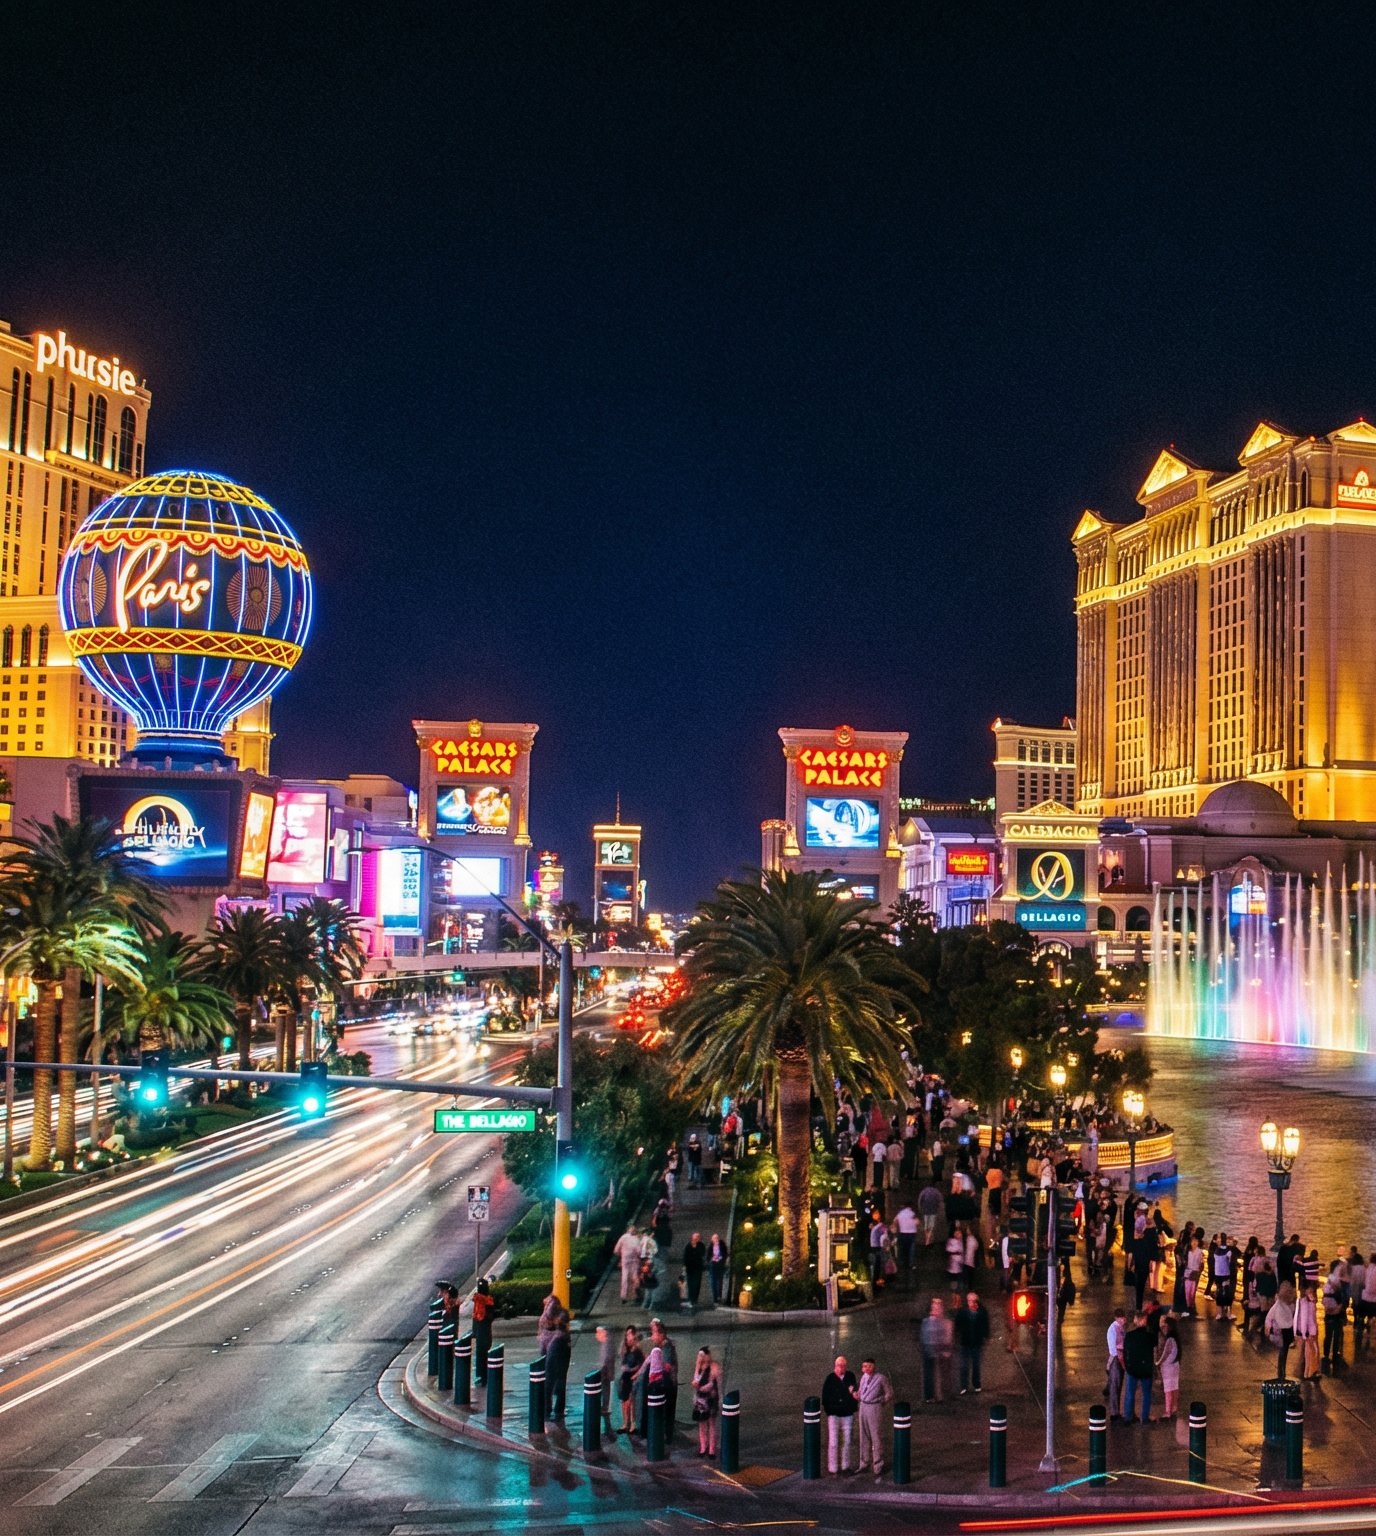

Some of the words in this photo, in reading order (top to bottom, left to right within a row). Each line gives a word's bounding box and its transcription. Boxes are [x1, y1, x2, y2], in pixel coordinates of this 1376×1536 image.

[115, 538, 211, 633] Paris
[431, 740, 518, 757] CAESARS
[437, 757, 512, 775] PALACE
[799, 750, 888, 769] CAESARS
[805, 769, 882, 787] PALACE
[1021, 913, 1082, 922] BELLAGIO
[442, 1114, 466, 1129] THE
